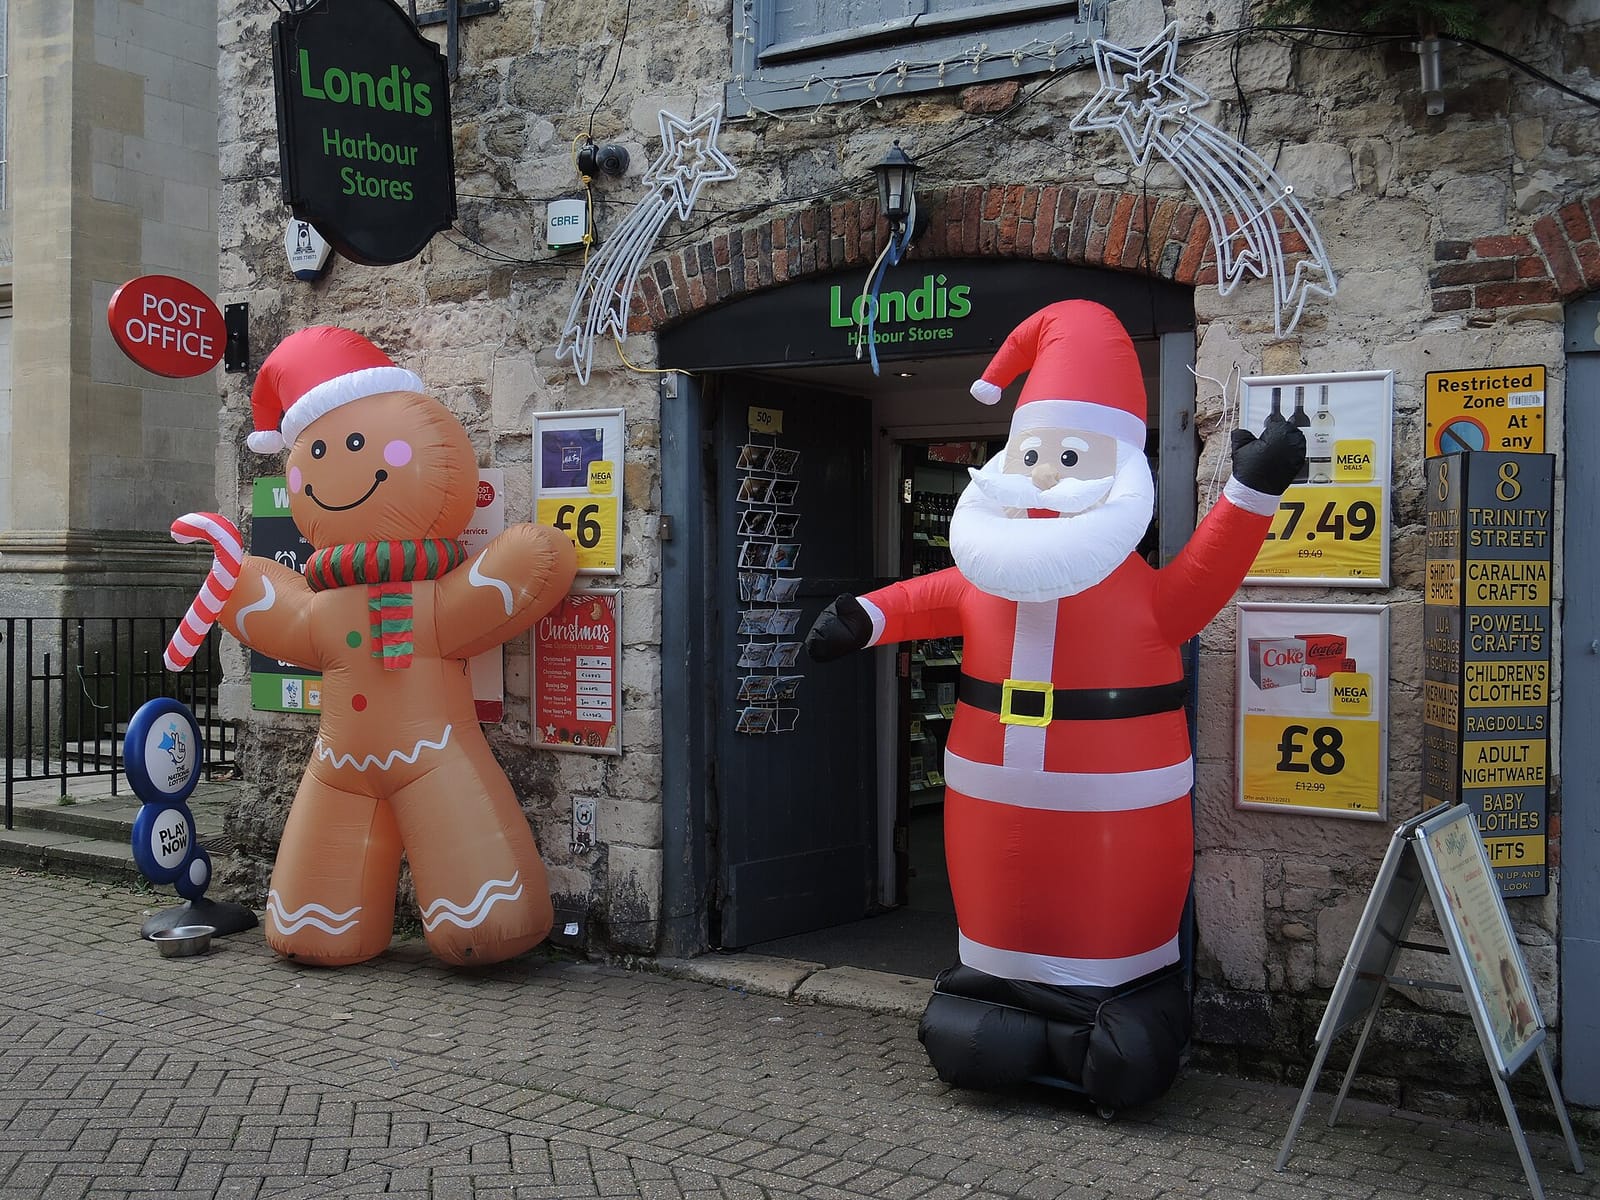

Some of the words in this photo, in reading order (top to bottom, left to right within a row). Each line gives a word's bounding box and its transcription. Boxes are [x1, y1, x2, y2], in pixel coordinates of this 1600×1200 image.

[299, 48, 433, 117] Londis
[322, 127, 418, 166] Harbour
[340, 166, 414, 201] Stores
[550, 215, 579, 227] CBRE
[830, 274, 972, 328] Londis
[143, 293, 206, 329] POST
[125, 318, 214, 360] OFFICE
[908, 327, 953, 342] Stores
[1438, 373, 1533, 393] Restricted
[1463, 395, 1505, 409] Zone
[757, 411, 772, 426] 50p
[1508, 415, 1528, 429] At
[1502, 436, 1533, 450] any
[1337, 454, 1370, 465] MEGA
[590, 472, 611, 481] MEGA
[1438, 462, 1449, 502] 8
[1495, 461, 1521, 502] 8
[477, 486, 489, 494] OST
[1264, 501, 1376, 541] 7.49
[1428, 509, 1459, 527] TRINITY
[1469, 508, 1548, 527] TRINITY
[553, 504, 602, 549] £6
[1428, 530, 1459, 548] STREET
[1470, 530, 1547, 547] STREET
[1298, 549, 1323, 558] £9.49
[1430, 564, 1445, 580] SHIP
[1446, 564, 1455, 580] TO
[1468, 564, 1546, 581] CARALINA
[1431, 583, 1453, 599] SHORE
[1477, 583, 1537, 600] CRAFTS
[540, 615, 611, 643] Christmas
[1470, 614, 1544, 632] POWELL
[1426, 637, 1459, 654] HANDBAGS
[1471, 634, 1541, 652] CRAFTS
[1263, 648, 1303, 667] Coke
[1431, 656, 1459, 673] SCARVES
[1466, 665, 1545, 682] CHILDREN'S
[1334, 687, 1368, 698] MEGA
[1426, 684, 1458, 706] MERMAIDS
[1469, 684, 1542, 701] CLOTHES
[1432, 704, 1456, 725] FAIRIES
[1466, 715, 1544, 732] RAGDOLLS
[1276, 725, 1345, 775] £8
[1478, 745, 1530, 764] ADULT
[176, 765, 185, 773] THE
[1463, 766, 1544, 783] NIGHTWARE
[1295, 781, 1325, 792] £12.99
[1483, 793, 1524, 812] BABY
[1477, 812, 1539, 831] LOTHES
[159, 821, 185, 843] PLAY
[162, 834, 187, 856] NOW
[1507, 872, 1520, 880] UP
[1521, 870, 1541, 879] AND
[1503, 883, 1532, 892] LOOK!
